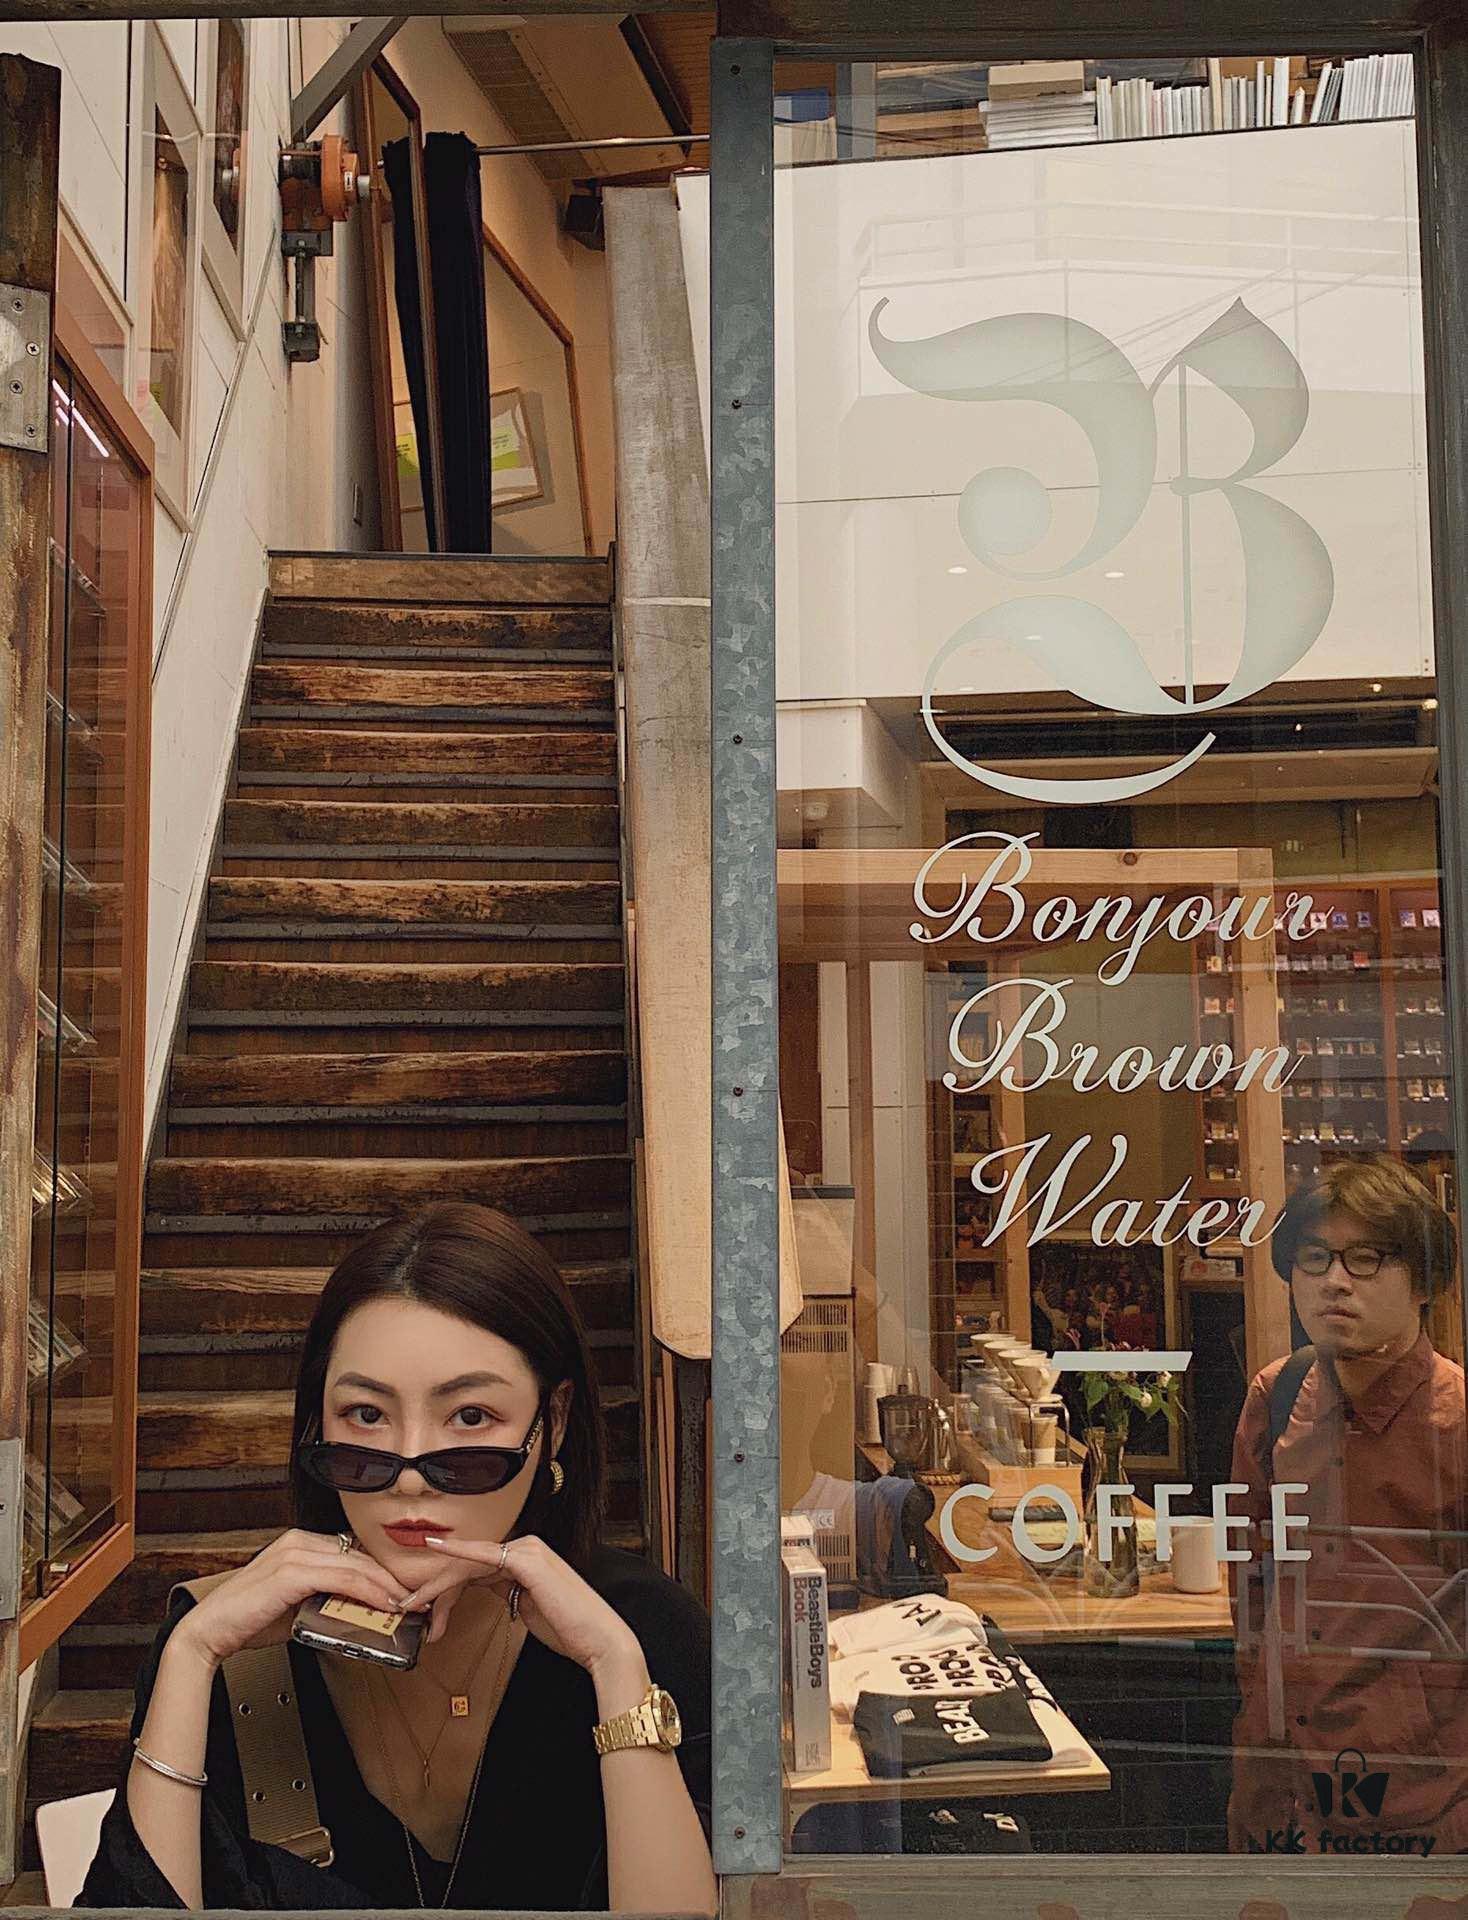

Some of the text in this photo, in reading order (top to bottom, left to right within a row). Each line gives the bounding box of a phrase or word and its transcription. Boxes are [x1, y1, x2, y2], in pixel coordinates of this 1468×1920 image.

[909, 831, 1335, 986] Bonjour
[942, 978, 1305, 1093] Brown
[971, 1133, 1287, 1248] Water
[939, 1483, 1312, 1563] COFFEE
